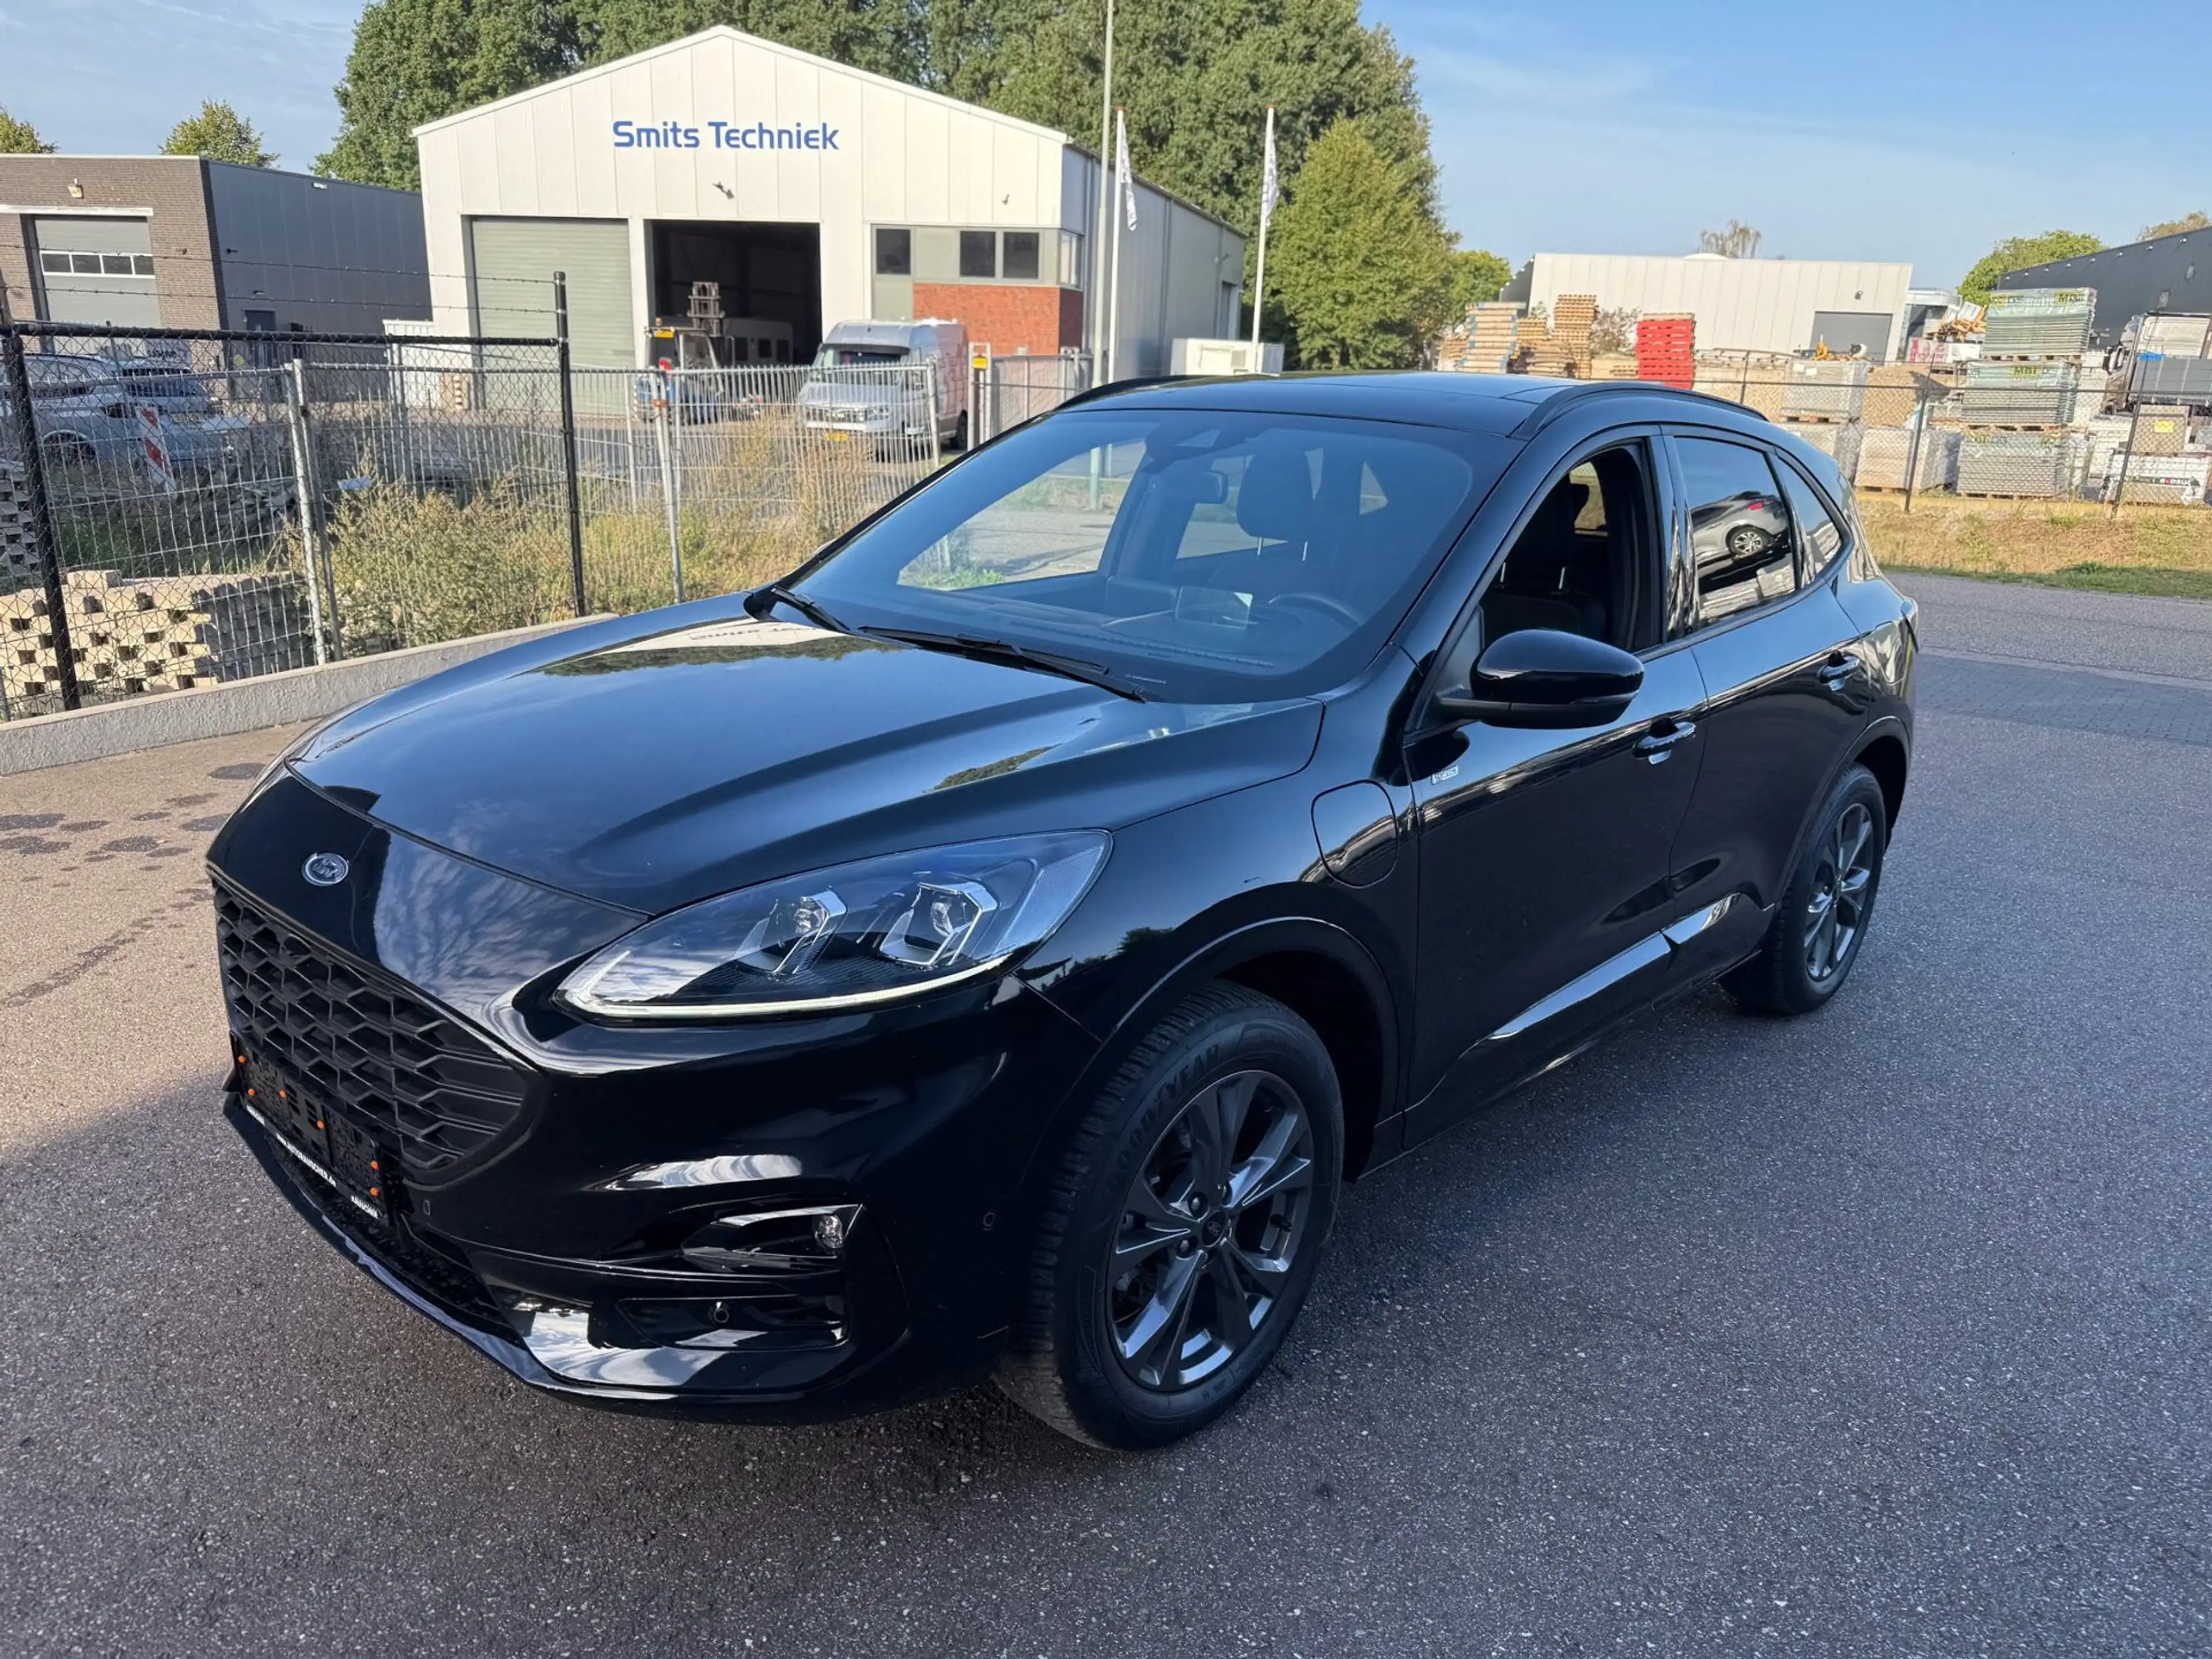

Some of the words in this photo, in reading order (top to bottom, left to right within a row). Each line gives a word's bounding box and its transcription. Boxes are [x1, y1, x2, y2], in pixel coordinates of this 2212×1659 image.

[612, 121, 700, 148] Smits
[708, 122, 840, 150] Techniek
[1107, 1043, 1219, 1192] GOODYEAR
